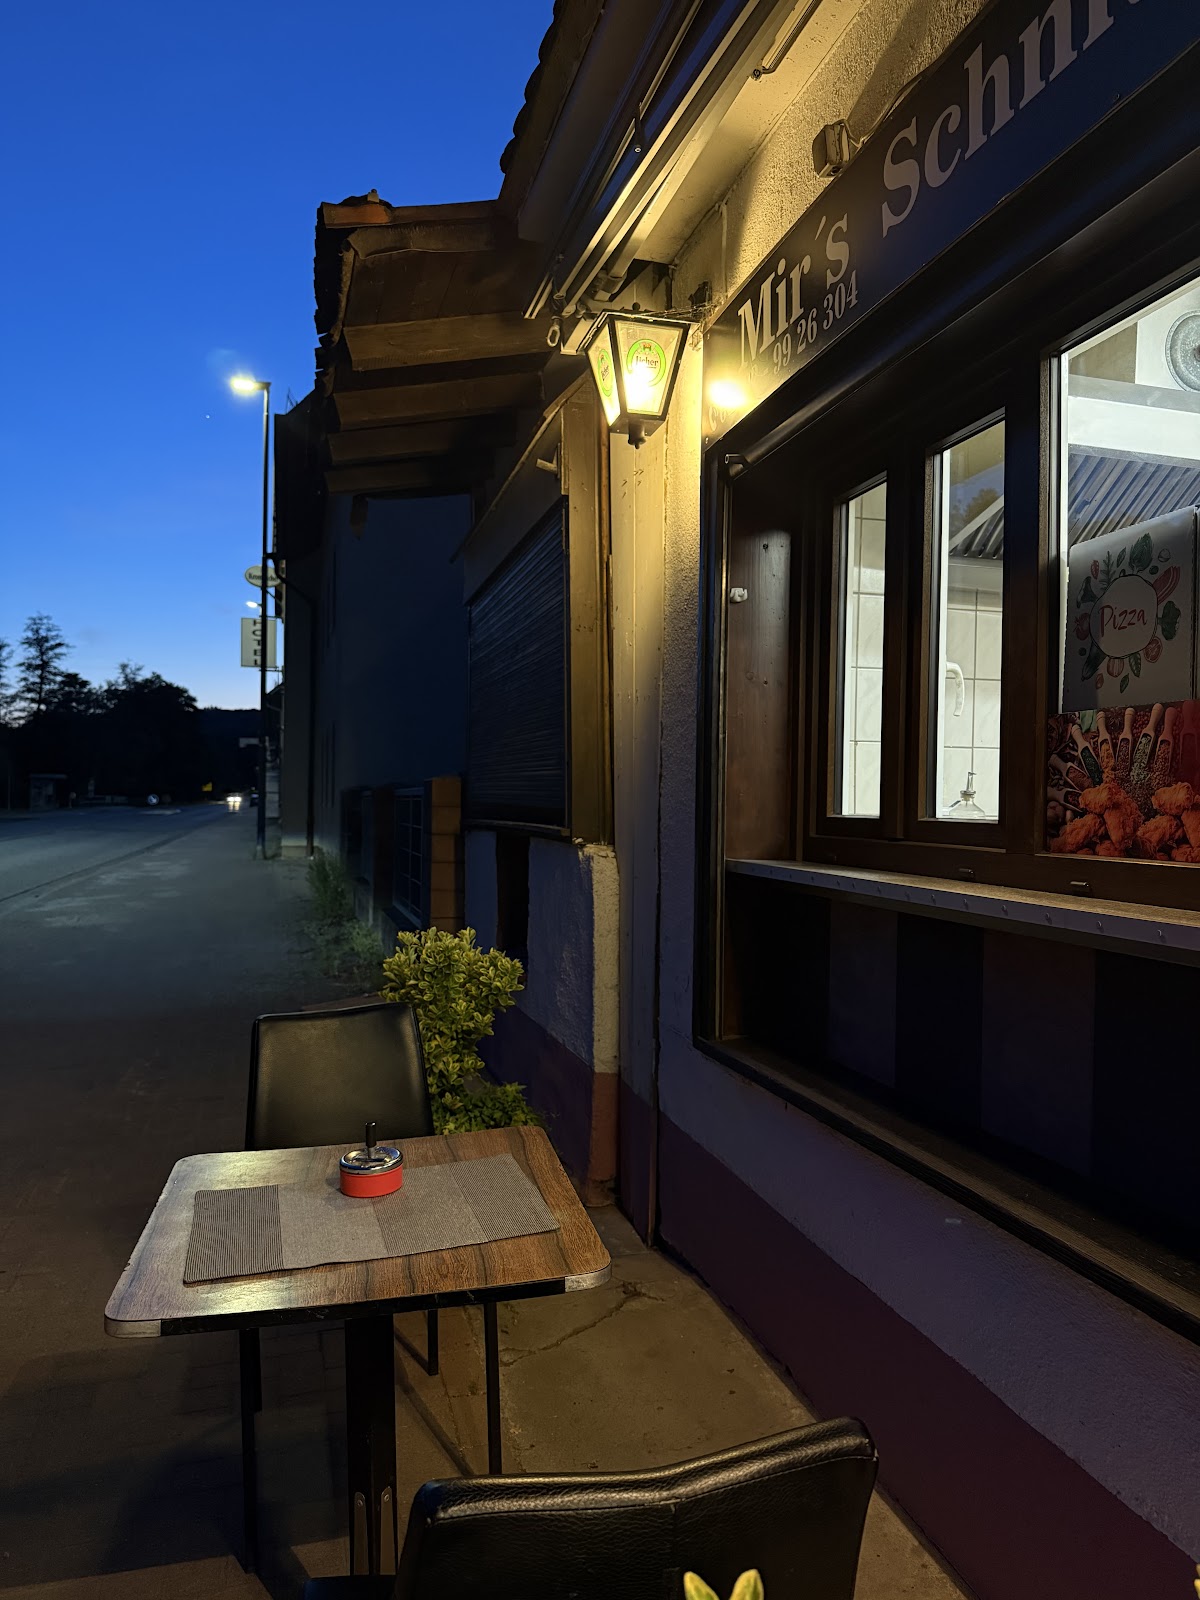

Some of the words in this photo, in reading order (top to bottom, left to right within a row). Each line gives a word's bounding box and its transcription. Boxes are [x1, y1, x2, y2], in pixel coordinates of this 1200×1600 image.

[882, 0, 1143, 238] Schn
[773, 335, 792, 375] 99
[796, 307, 818, 355] 26
[822, 269, 859, 330] 304
[1099, 604, 1147, 637] Pizza
